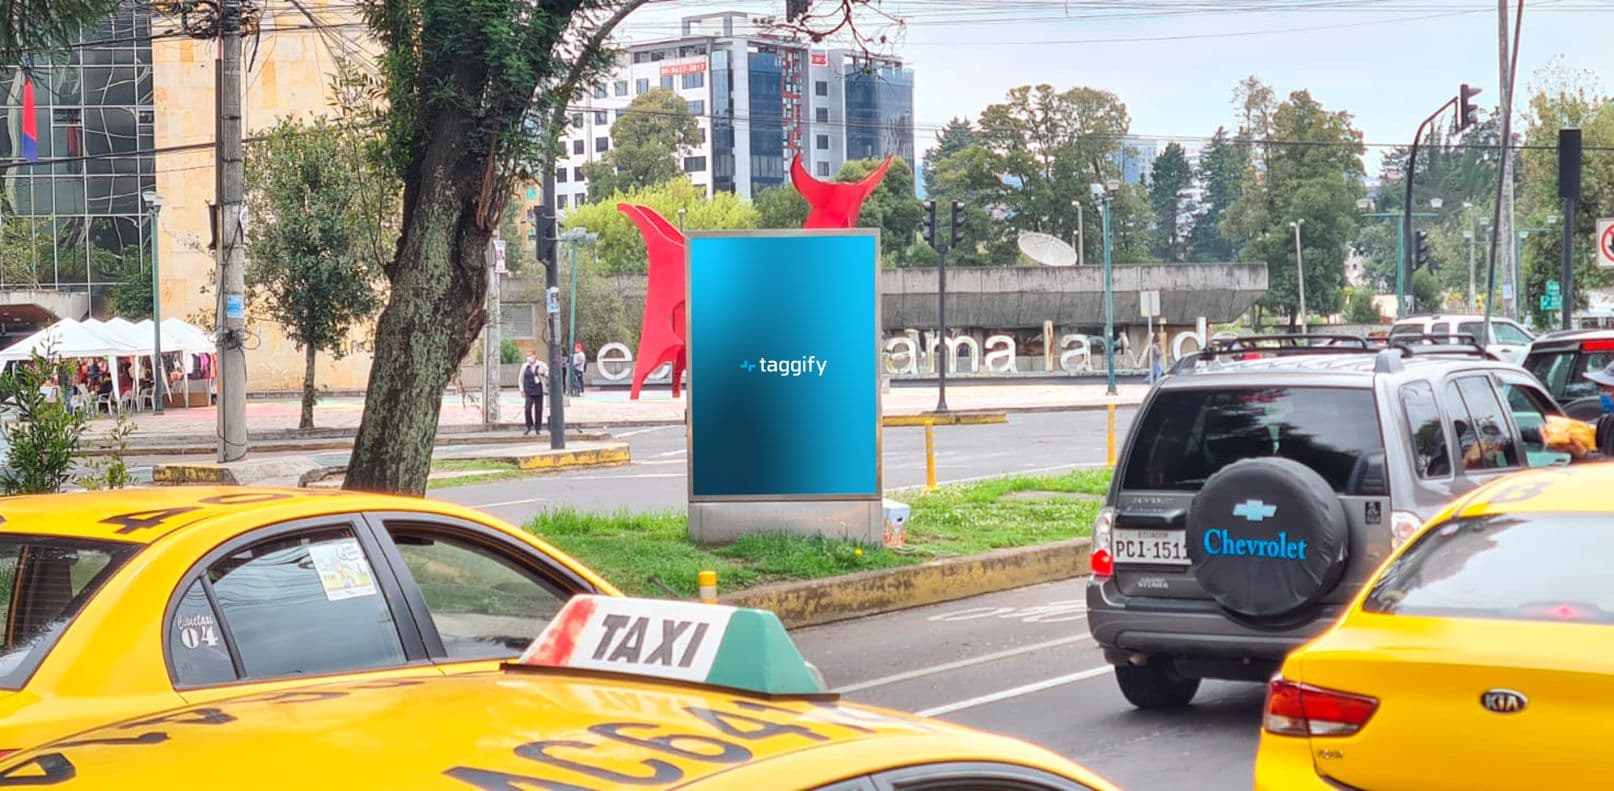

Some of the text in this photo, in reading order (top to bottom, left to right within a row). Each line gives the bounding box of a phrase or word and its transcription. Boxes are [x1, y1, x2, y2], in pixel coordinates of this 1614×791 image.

[1043, 320, 1093, 372] la
[760, 355, 827, 376] taggify
[1203, 528, 1308, 560] Chevrolet
[181, 625, 218, 649] 04
[592, 614, 710, 668] TAXI
[1484, 693, 1519, 710] KIA
